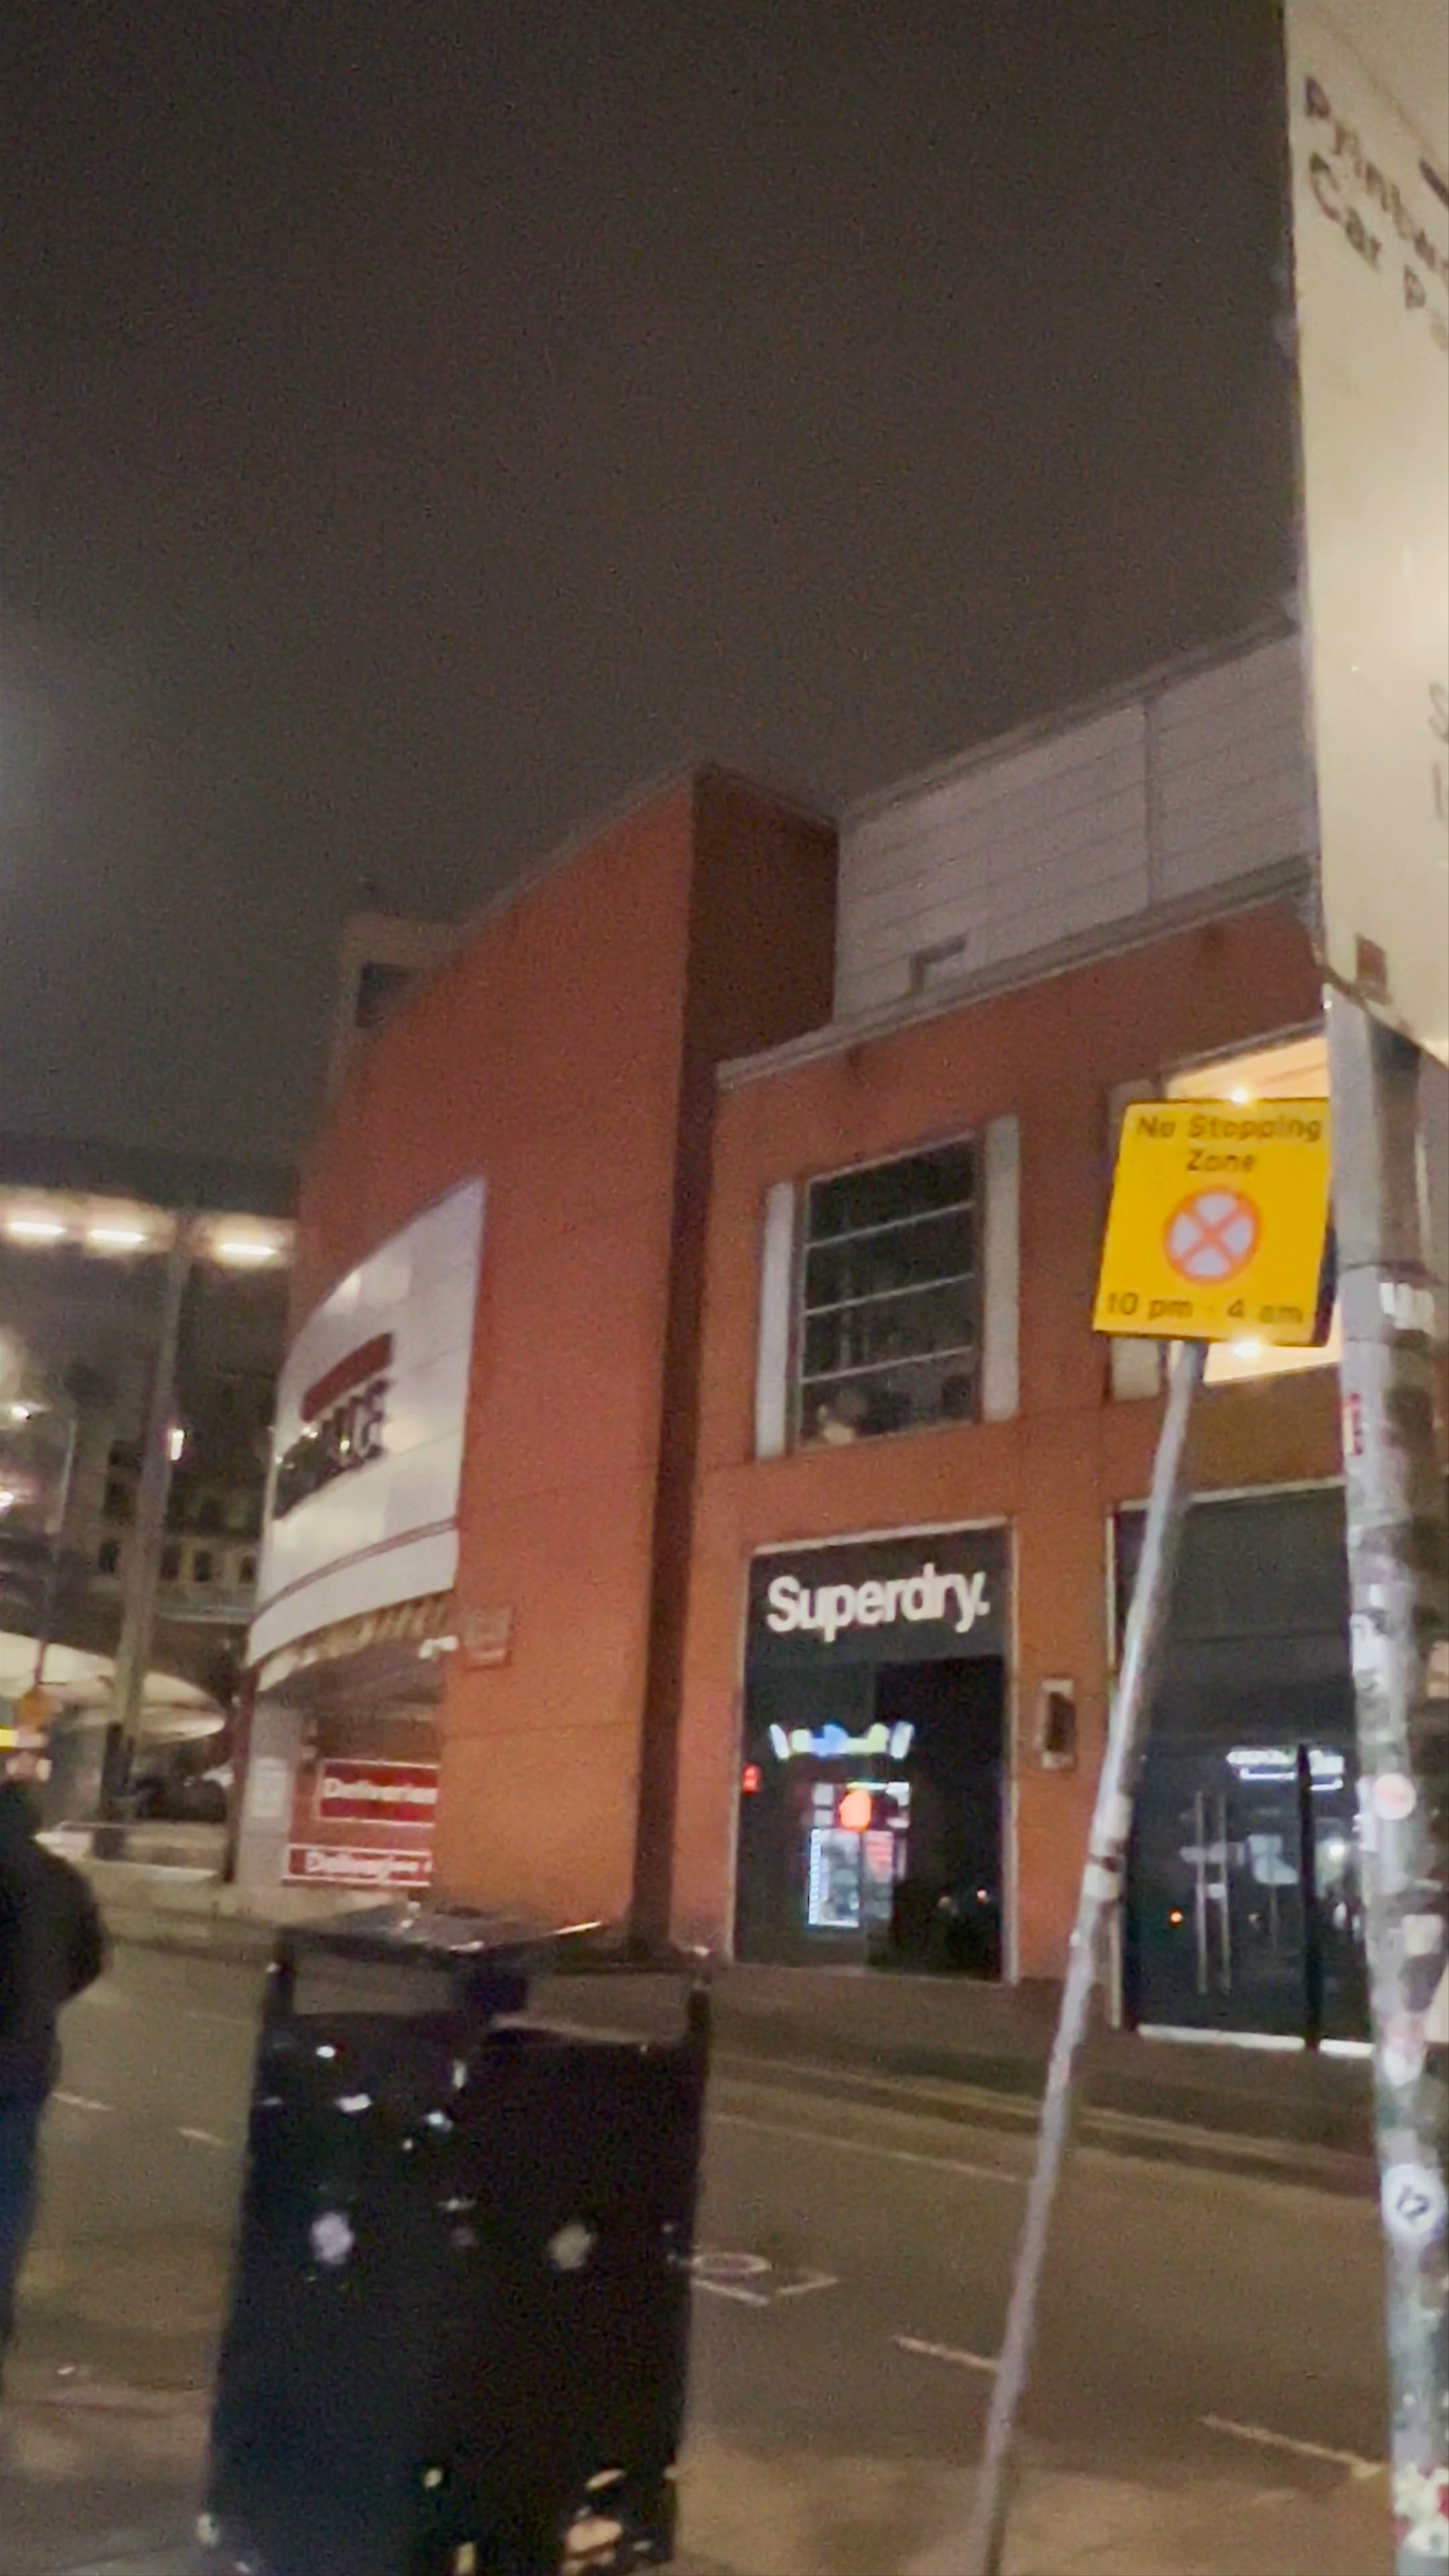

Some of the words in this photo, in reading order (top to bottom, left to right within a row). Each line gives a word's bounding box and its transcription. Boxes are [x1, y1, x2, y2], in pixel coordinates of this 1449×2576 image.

[1309, 152, 1382, 272] Car
[1137, 1116, 1175, 1139] No
[1188, 1116, 1321, 1142] Stopping
[1186, 1150, 1257, 1172] Zone
[1108, 1292, 1139, 1315] 10
[1148, 1299, 1193, 1320] pm
[1227, 1299, 1245, 1318] 4
[1260, 1305, 1303, 1324] am
